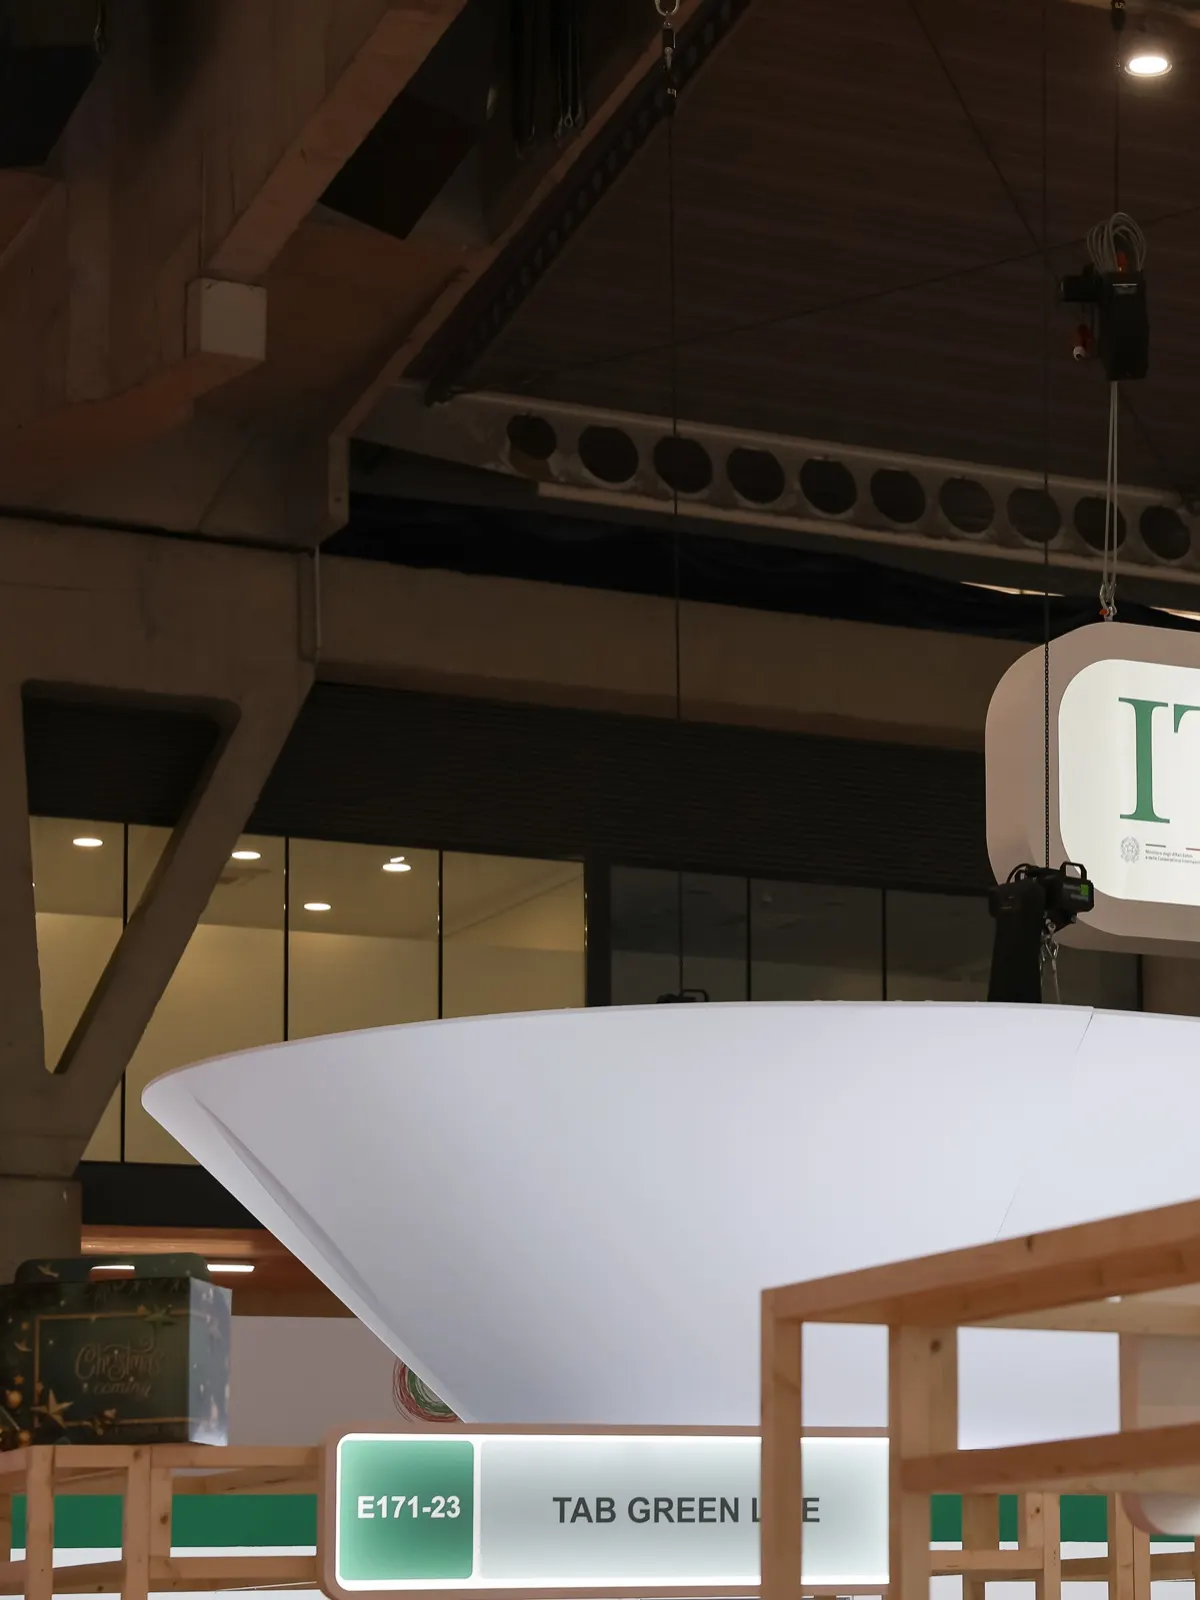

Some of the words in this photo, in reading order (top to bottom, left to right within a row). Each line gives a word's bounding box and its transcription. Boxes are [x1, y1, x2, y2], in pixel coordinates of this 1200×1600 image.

[358, 1496, 460, 1518] E171-23
[553, 1497, 616, 1523] TAB
[628, 1497, 739, 1523] GREEN
[752, 1497, 820, 1523] LE
